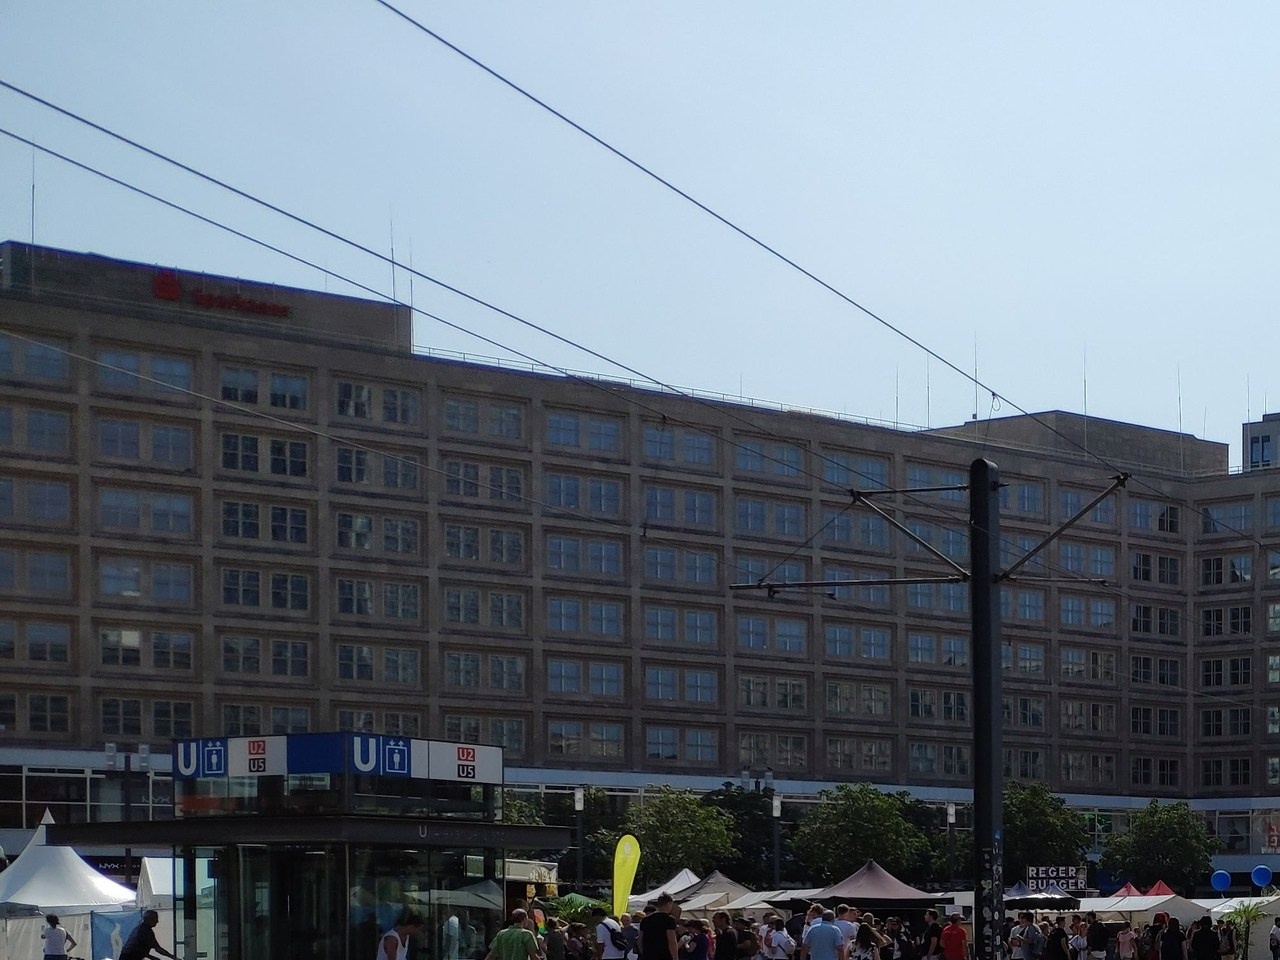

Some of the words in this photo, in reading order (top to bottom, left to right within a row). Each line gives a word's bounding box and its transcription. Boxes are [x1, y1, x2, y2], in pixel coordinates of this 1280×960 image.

[249, 741, 265, 754] U2
[177, 742, 197, 776] U
[353, 736, 377, 772] U
[459, 748, 475, 760] U2
[249, 759, 265, 771] U5
[459, 765, 475, 777] U5
[1028, 866, 1077, 878] REGER
